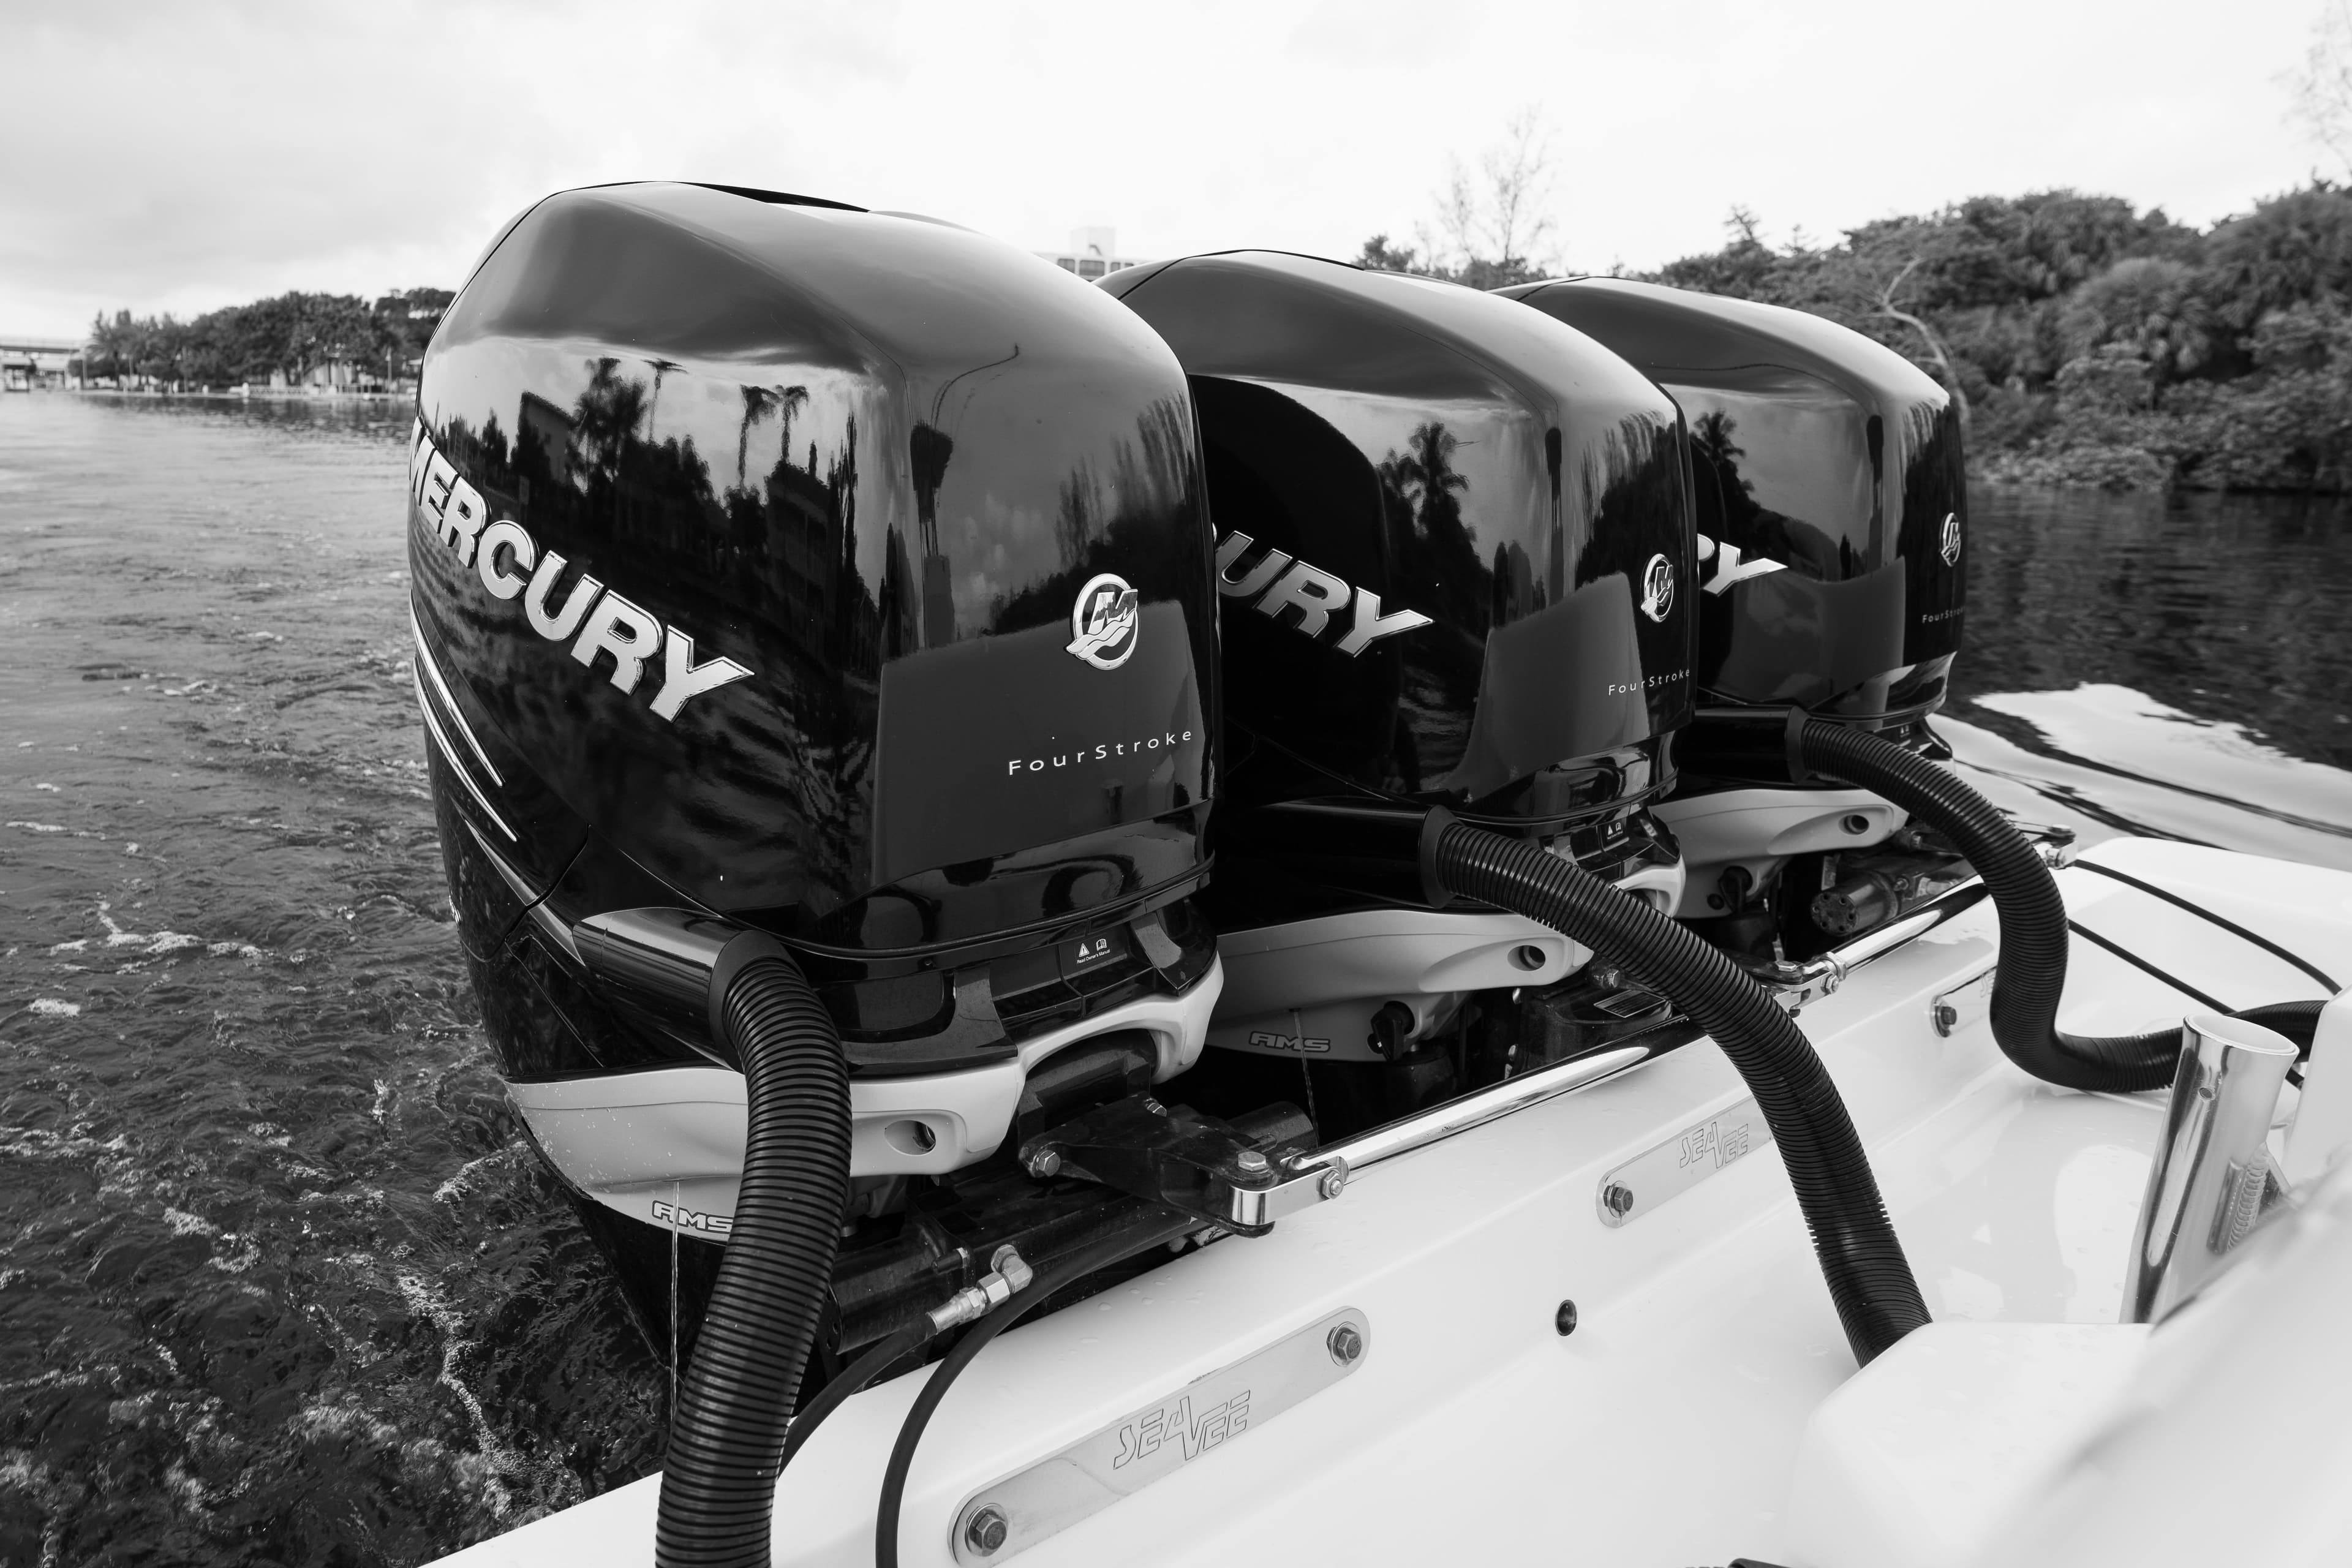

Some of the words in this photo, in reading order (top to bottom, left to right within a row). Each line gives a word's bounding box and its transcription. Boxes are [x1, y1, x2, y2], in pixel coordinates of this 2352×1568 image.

[409, 416, 755, 723] MERCURY
[1212, 522, 1434, 658] URY
[1608, 668, 1690, 695] FourStroke
[1009, 731, 1191, 775] FourStroke
[1249, 1031, 1330, 1052] AMS
